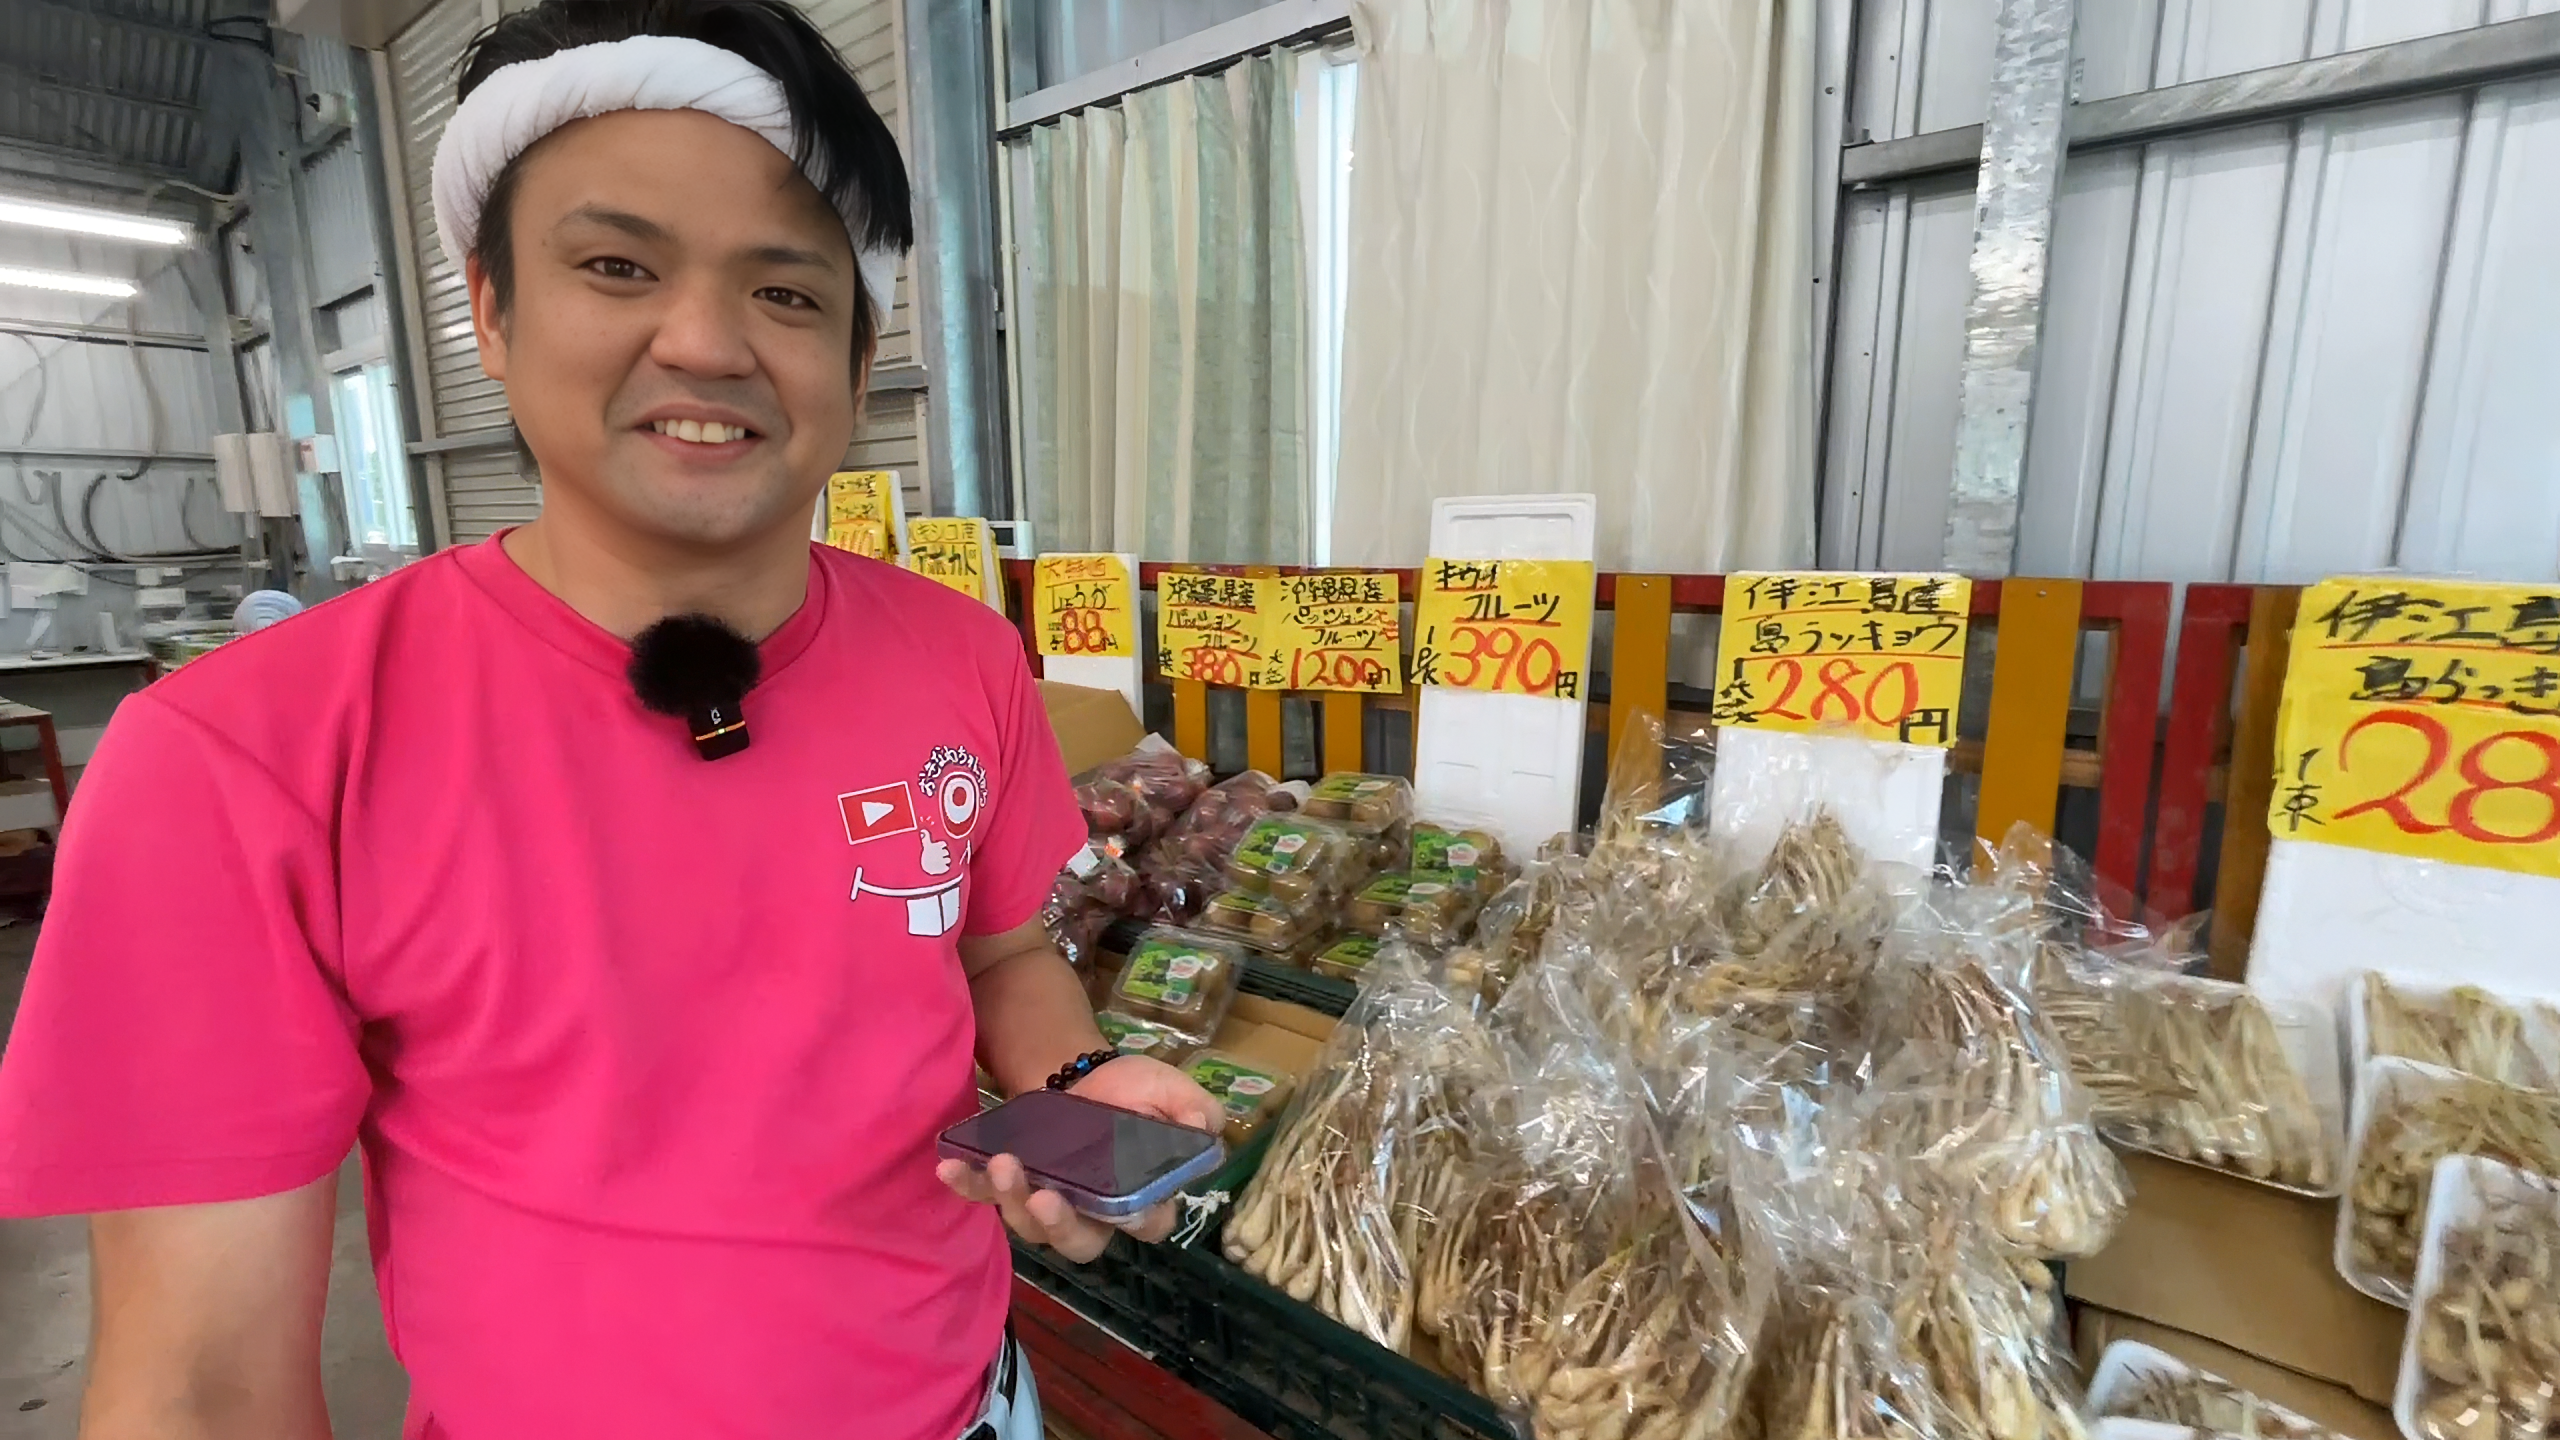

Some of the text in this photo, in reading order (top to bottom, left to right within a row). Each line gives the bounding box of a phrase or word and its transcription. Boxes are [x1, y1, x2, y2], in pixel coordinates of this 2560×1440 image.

[1463, 593, 1561, 624] フルーツ
[1197, 633, 1258, 653] フルーツ
[1311, 628, 1377, 649] フルーツ
